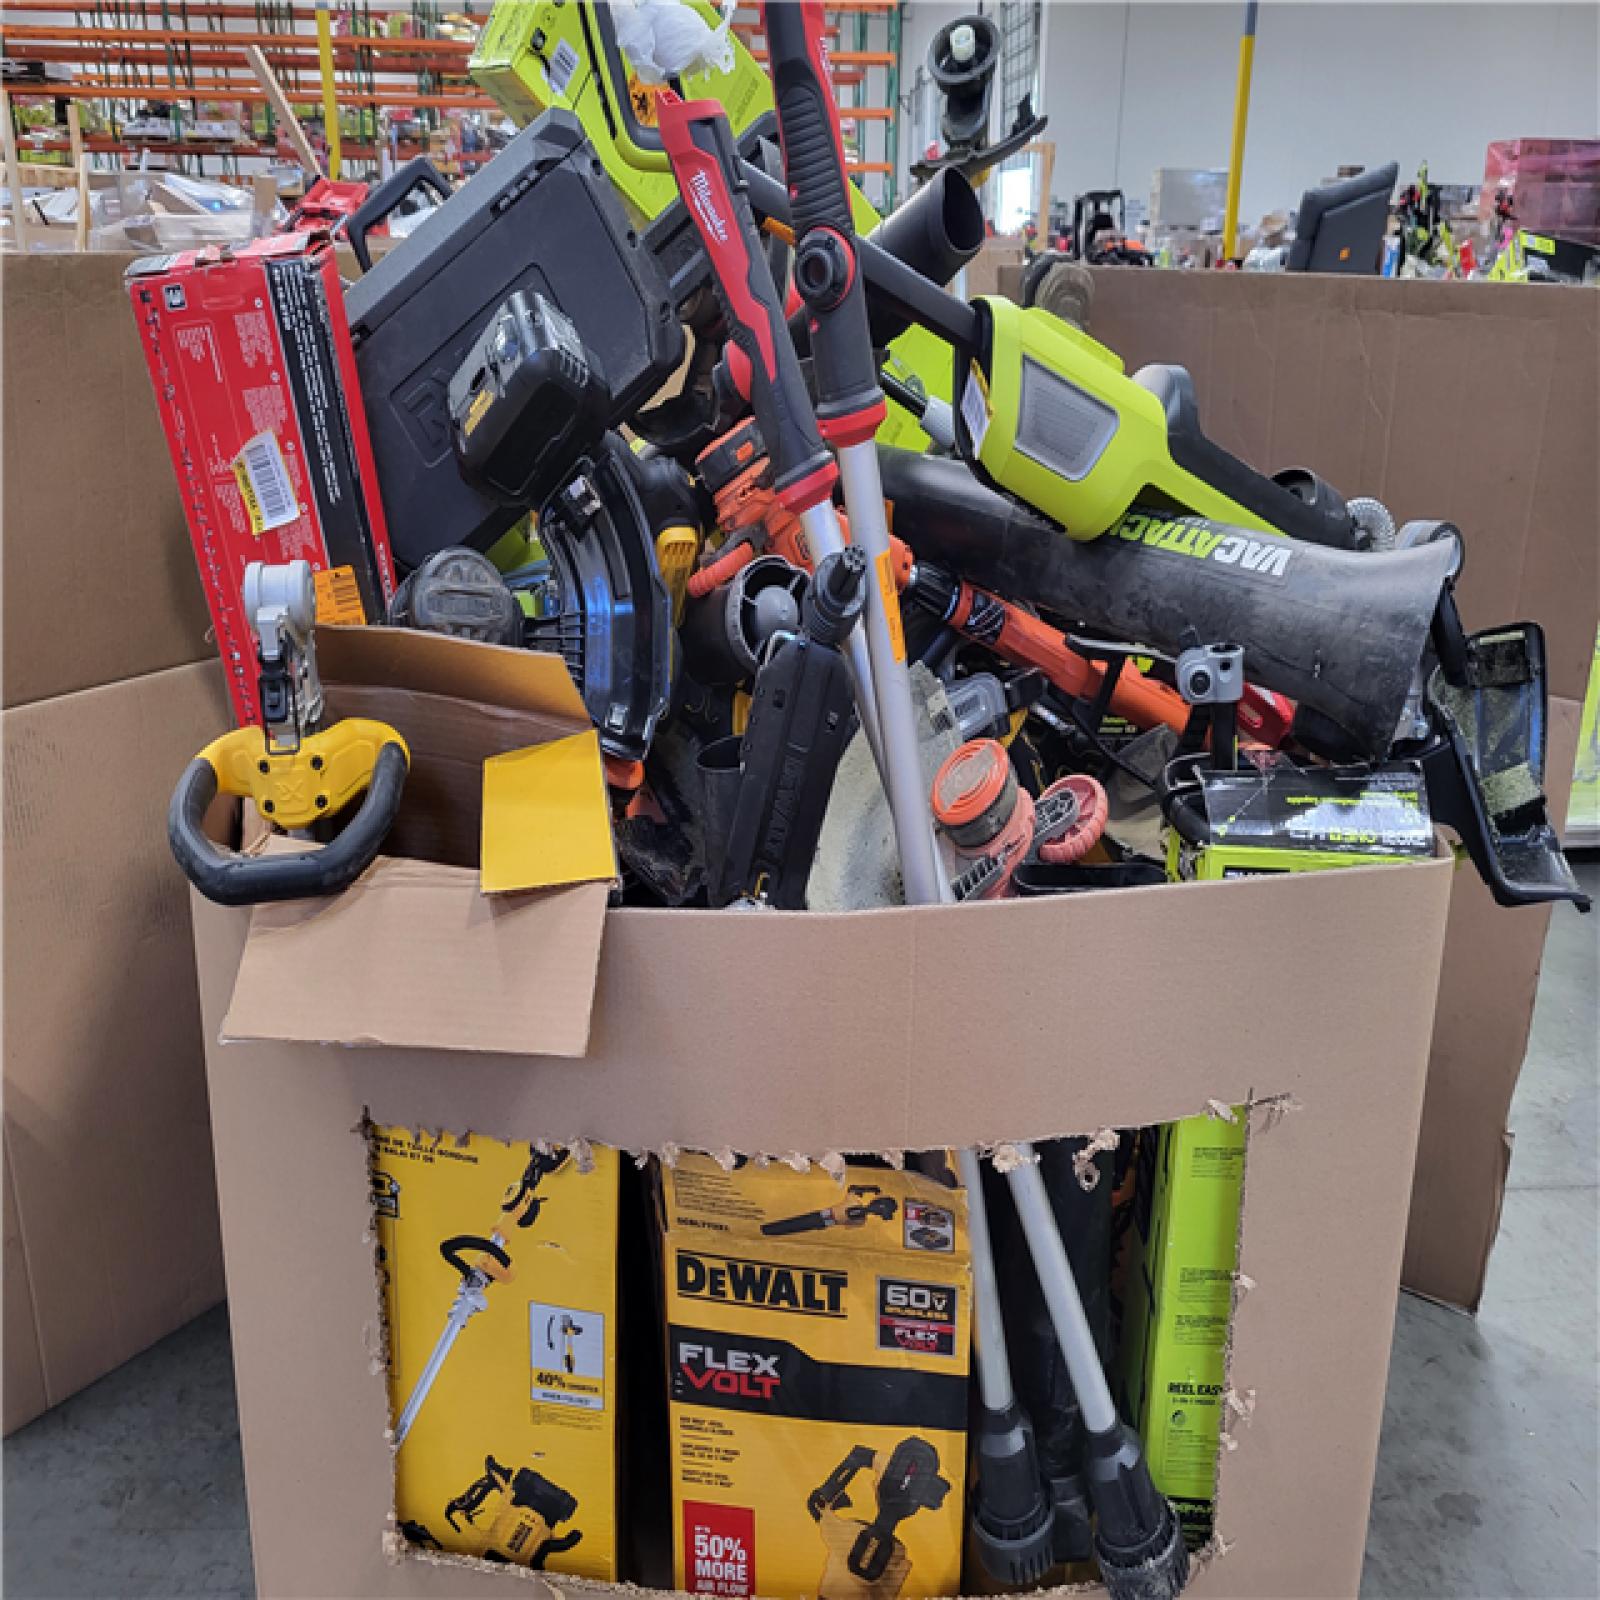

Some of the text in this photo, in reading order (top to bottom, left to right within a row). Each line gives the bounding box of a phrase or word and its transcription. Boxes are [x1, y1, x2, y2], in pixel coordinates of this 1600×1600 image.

[1110, 514, 1291, 576] VACATTAC
[676, 1252, 848, 1314] DEWALT
[679, 1342, 780, 1376] FLEX
[680, 1363, 780, 1399] VOLT
[695, 1534, 747, 1561] 50%
[695, 1559, 748, 1582] MORE
